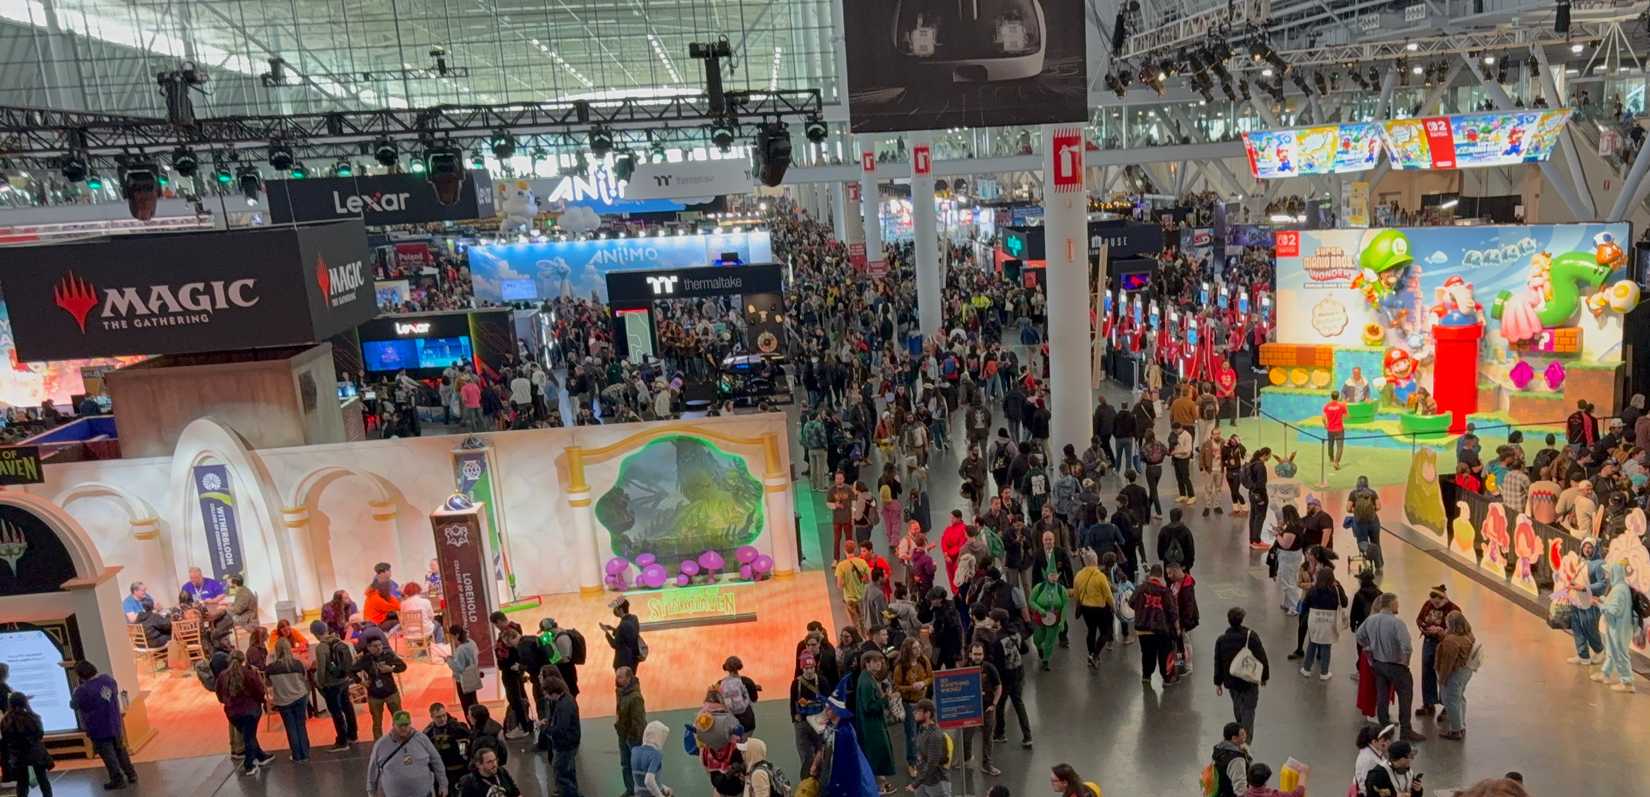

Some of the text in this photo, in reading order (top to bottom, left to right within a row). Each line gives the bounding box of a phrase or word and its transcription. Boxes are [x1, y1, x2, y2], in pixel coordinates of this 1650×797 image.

[332, 191, 410, 214] Lexar
[329, 260, 365, 295] MAGIC
[684, 276, 743, 291] thermaltake
[101, 278, 260, 318] MAGIC
[103, 313, 209, 330] THE GATHERING
[395, 321, 431, 335] Lexar
[2, 450, 17, 459] OF
[216, 506, 234, 566] WITHERBLOOM
[463, 573, 478, 623] LOREHOLD
